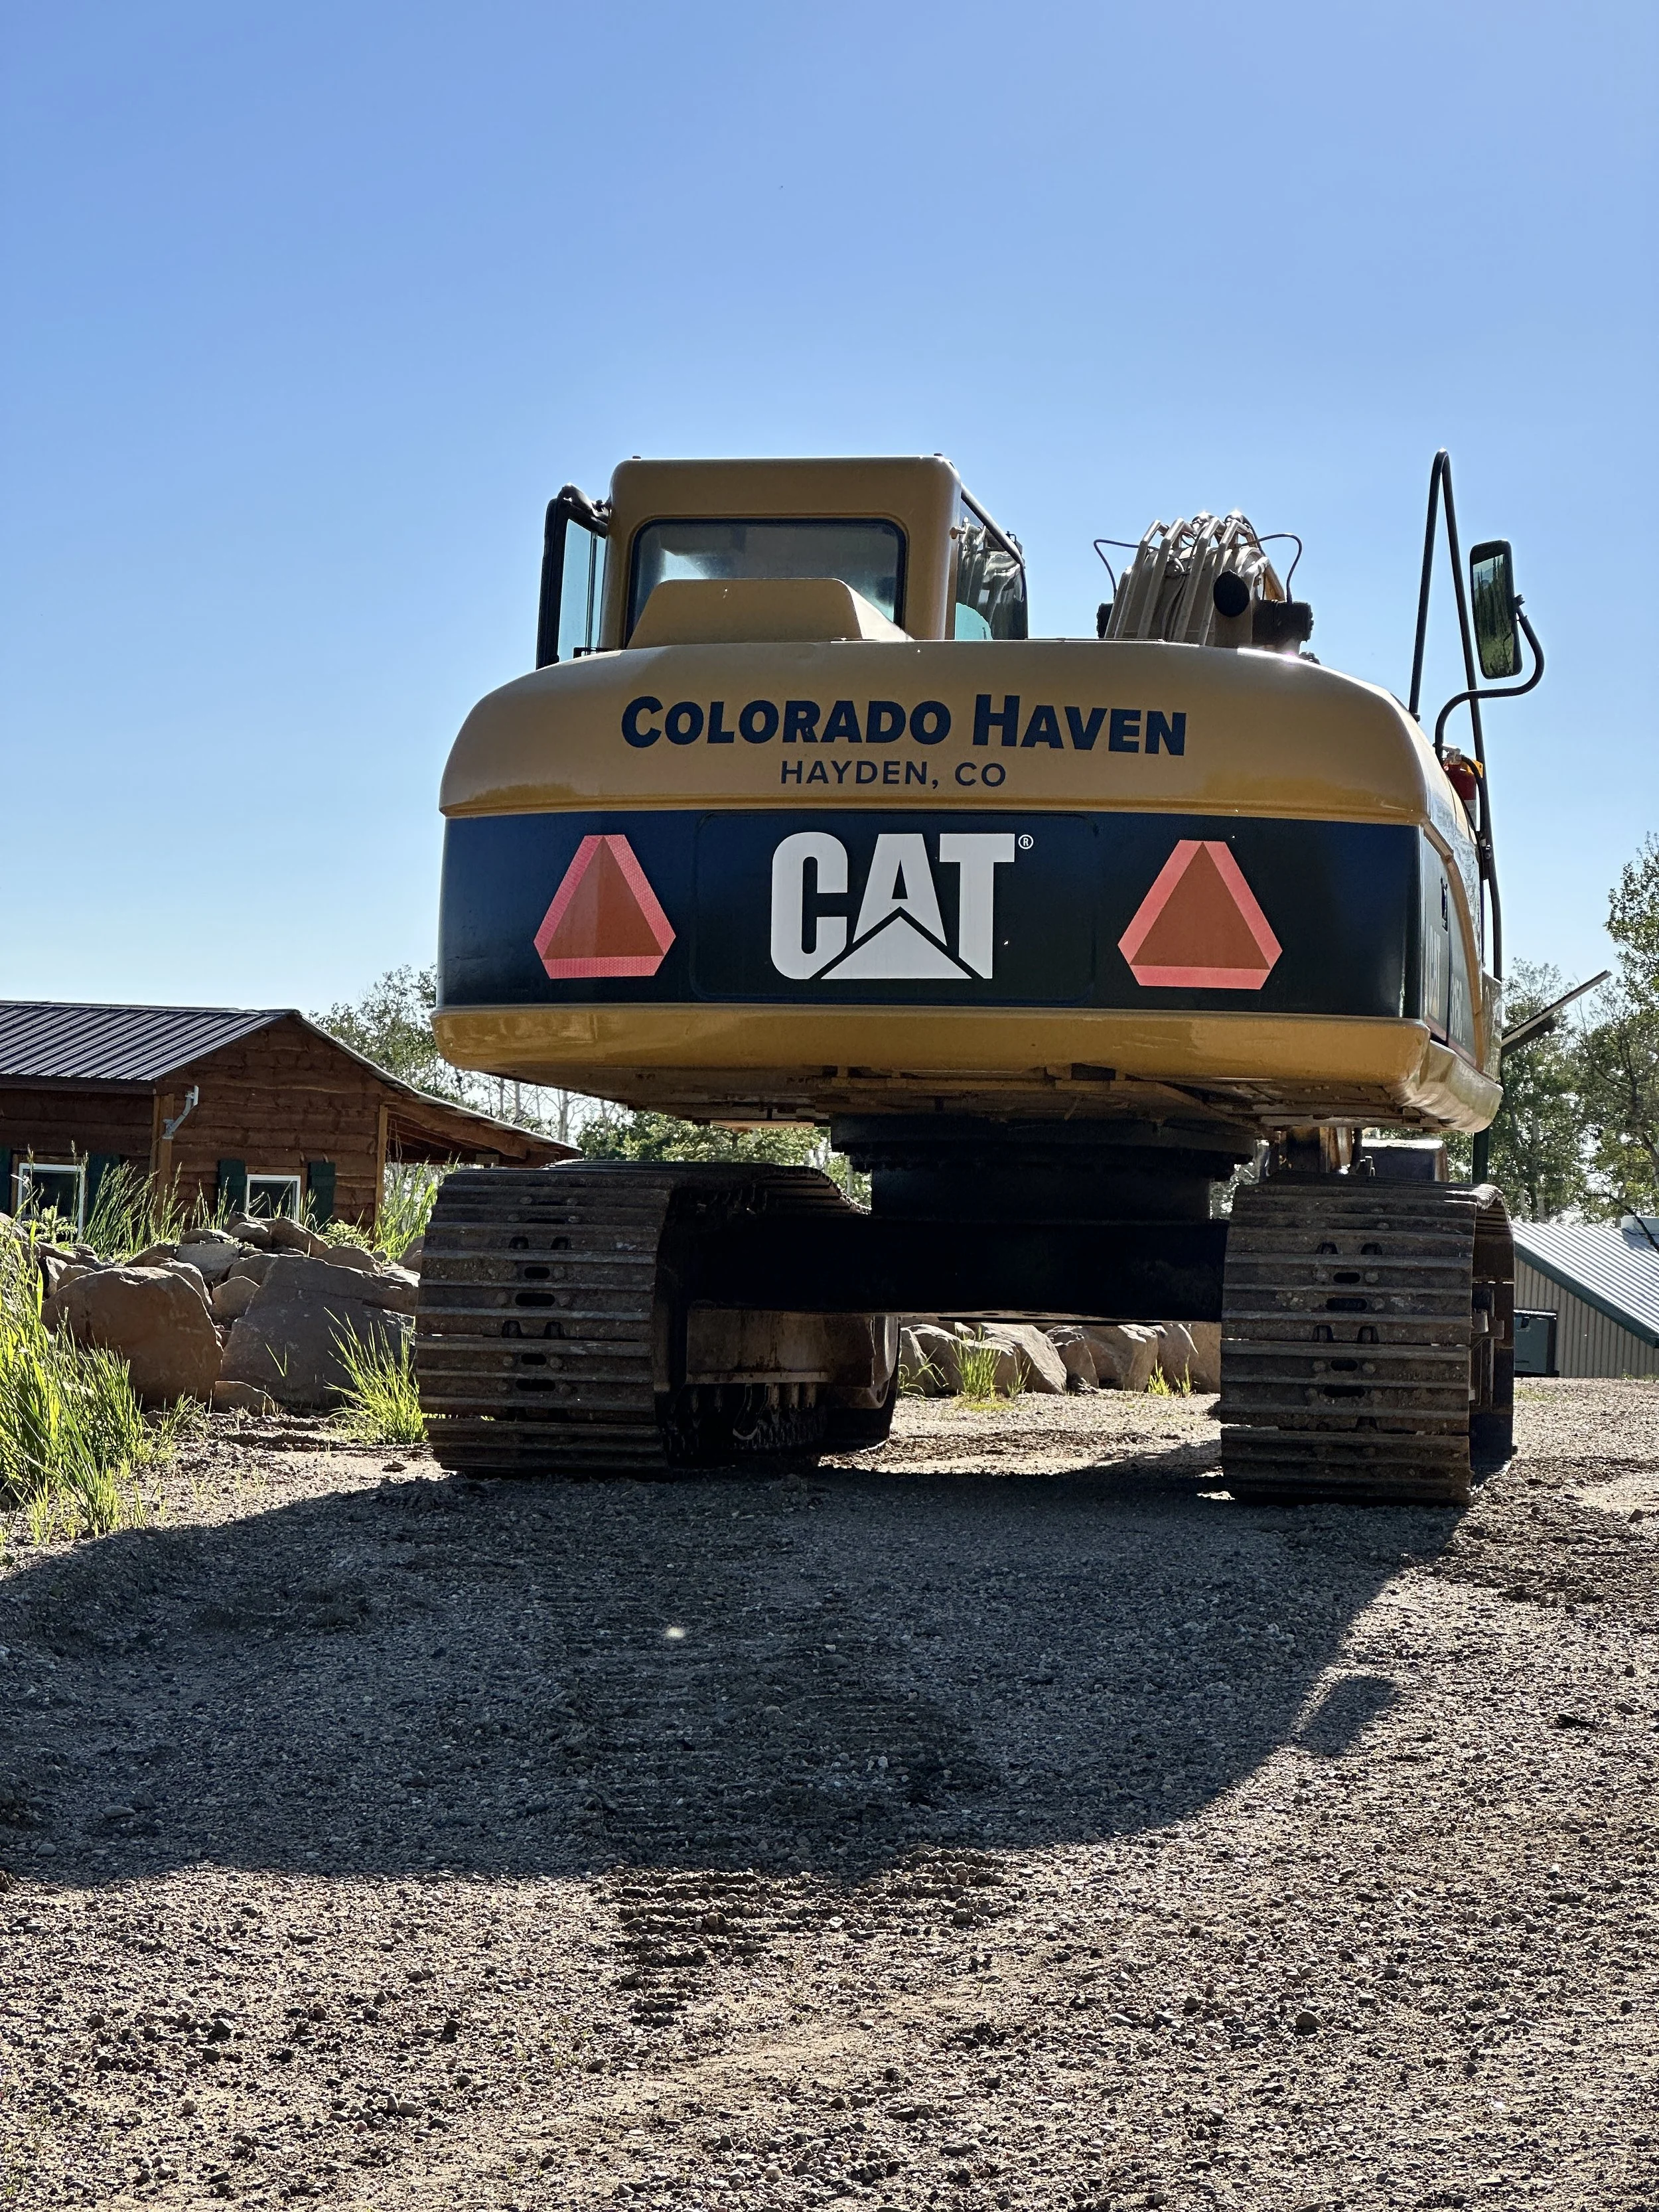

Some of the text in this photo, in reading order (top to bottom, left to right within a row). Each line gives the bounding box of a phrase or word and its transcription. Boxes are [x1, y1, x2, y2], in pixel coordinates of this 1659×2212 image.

[621, 694, 1187, 756] COLORADO HAVEN
[780, 760, 1007, 789] HAYDEN, CO
[1428, 924, 1441, 1021] CAT
